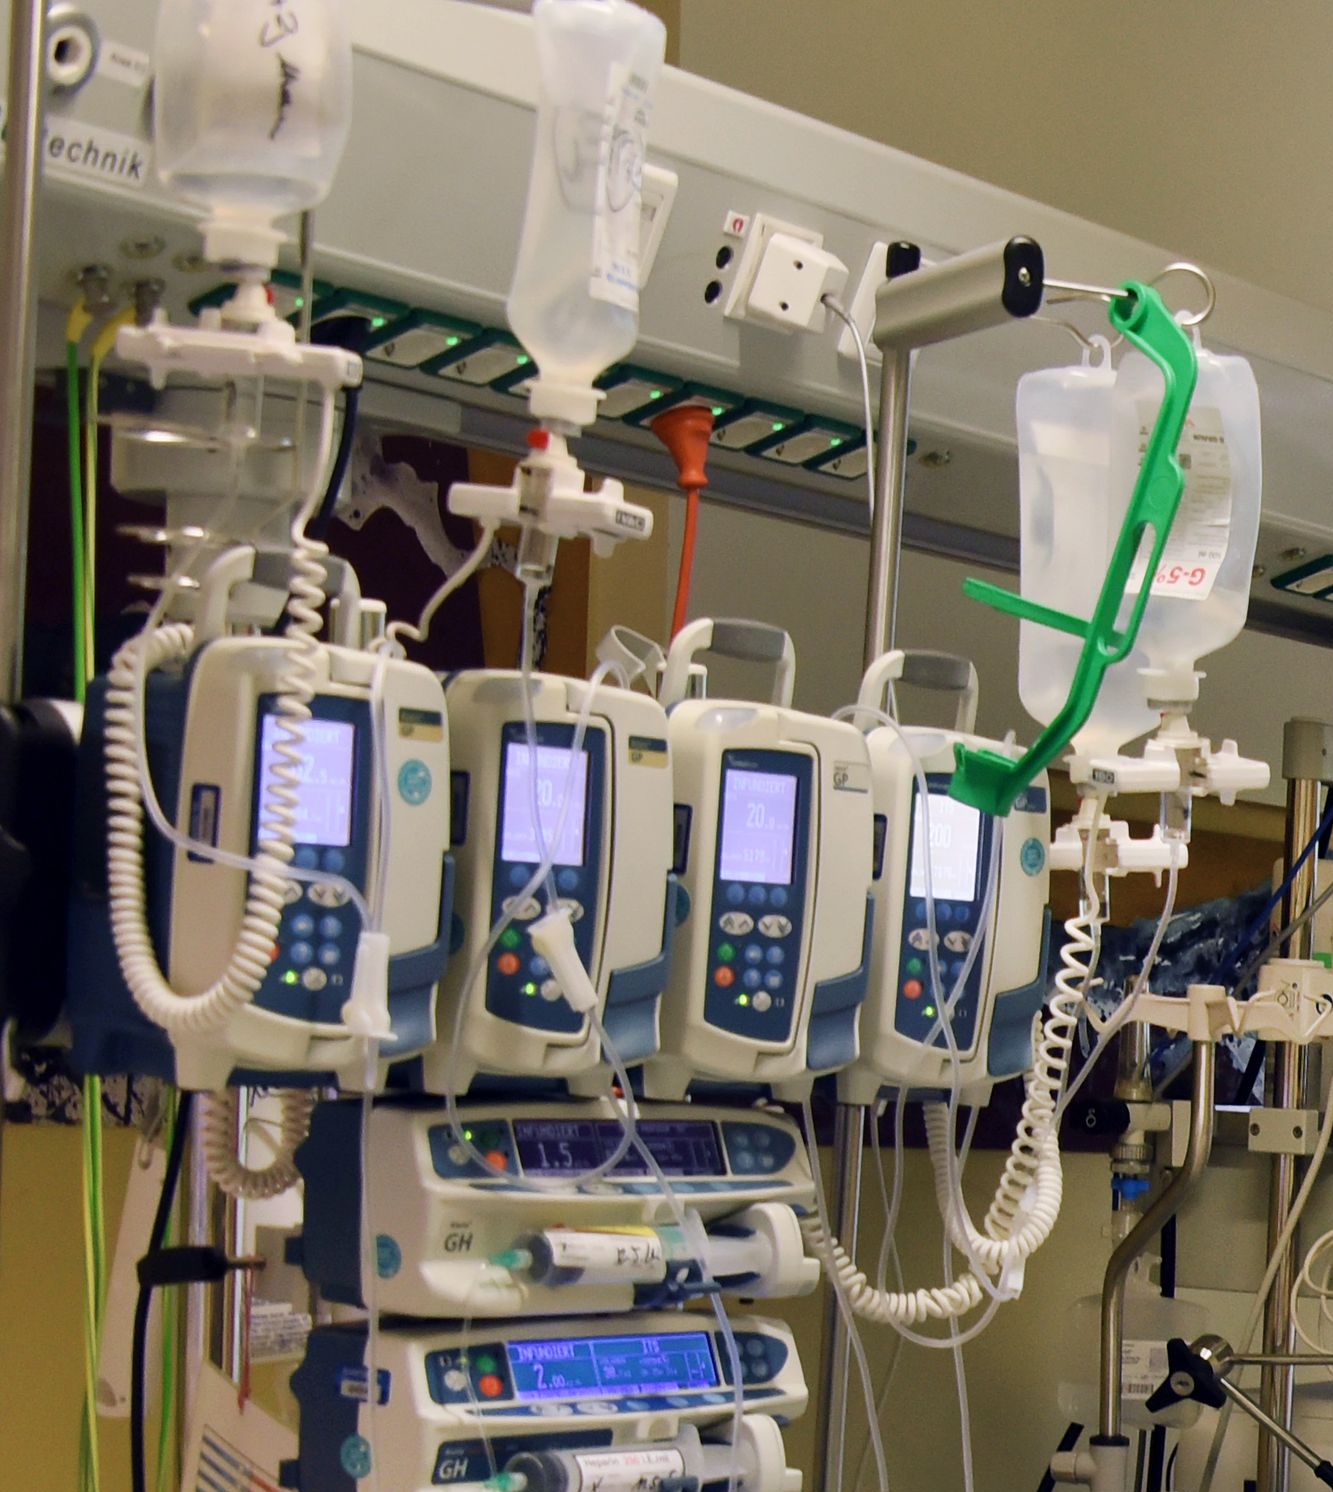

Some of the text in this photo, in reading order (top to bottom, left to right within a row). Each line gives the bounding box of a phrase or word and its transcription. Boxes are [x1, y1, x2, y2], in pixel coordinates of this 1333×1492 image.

[46, 135, 143, 180] echnik
[833, 771, 849, 786] GP
[538, 1142, 573, 1169] 1.5
[443, 1232, 474, 1252] GH
[439, 1458, 469, 1480] GH
